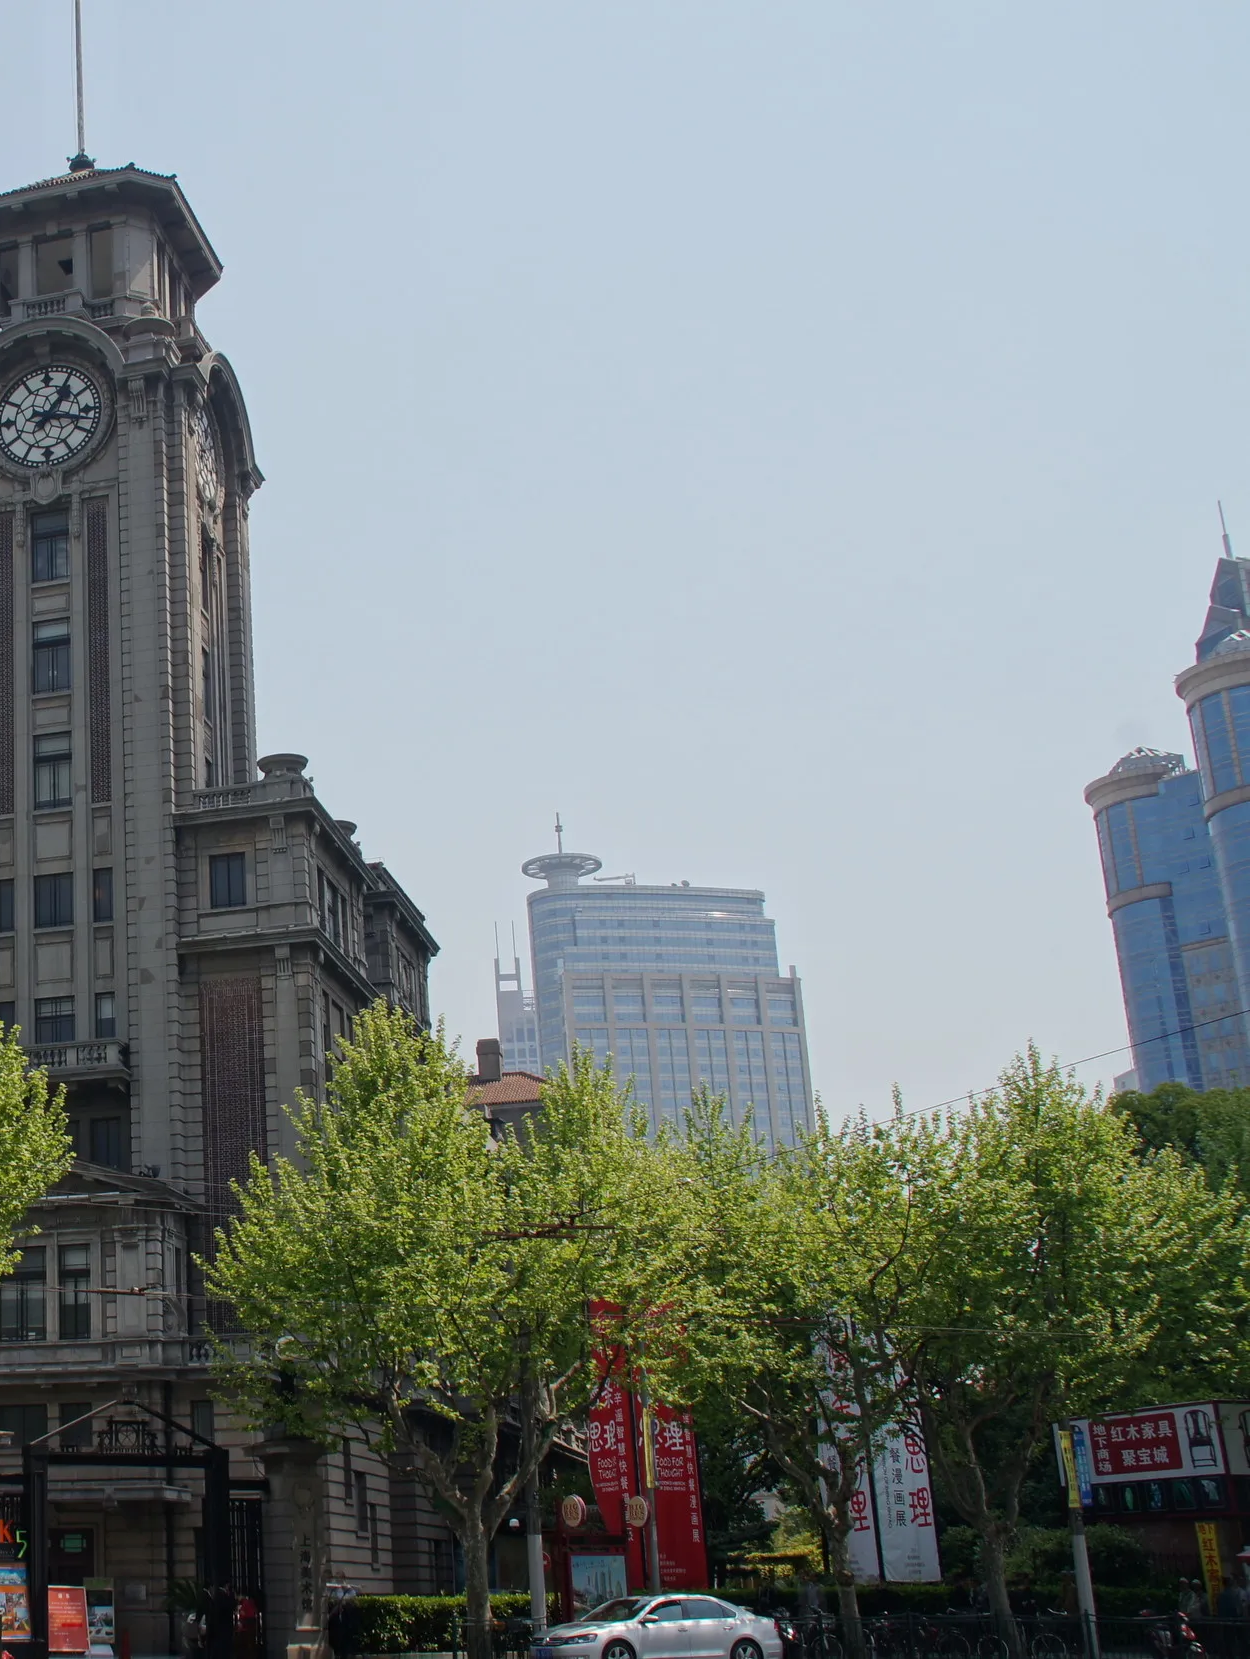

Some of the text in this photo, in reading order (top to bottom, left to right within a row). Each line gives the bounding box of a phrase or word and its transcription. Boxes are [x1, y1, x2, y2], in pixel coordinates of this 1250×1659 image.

[1110, 1420, 1173, 1442] 红木家具
[1092, 1424, 1112, 1473] 地下商场
[1120, 1446, 1170, 1467] 聚宝城
[655, 1456, 684, 1467] FOOD FOR
[655, 1467, 684, 1478] THOUGHT
